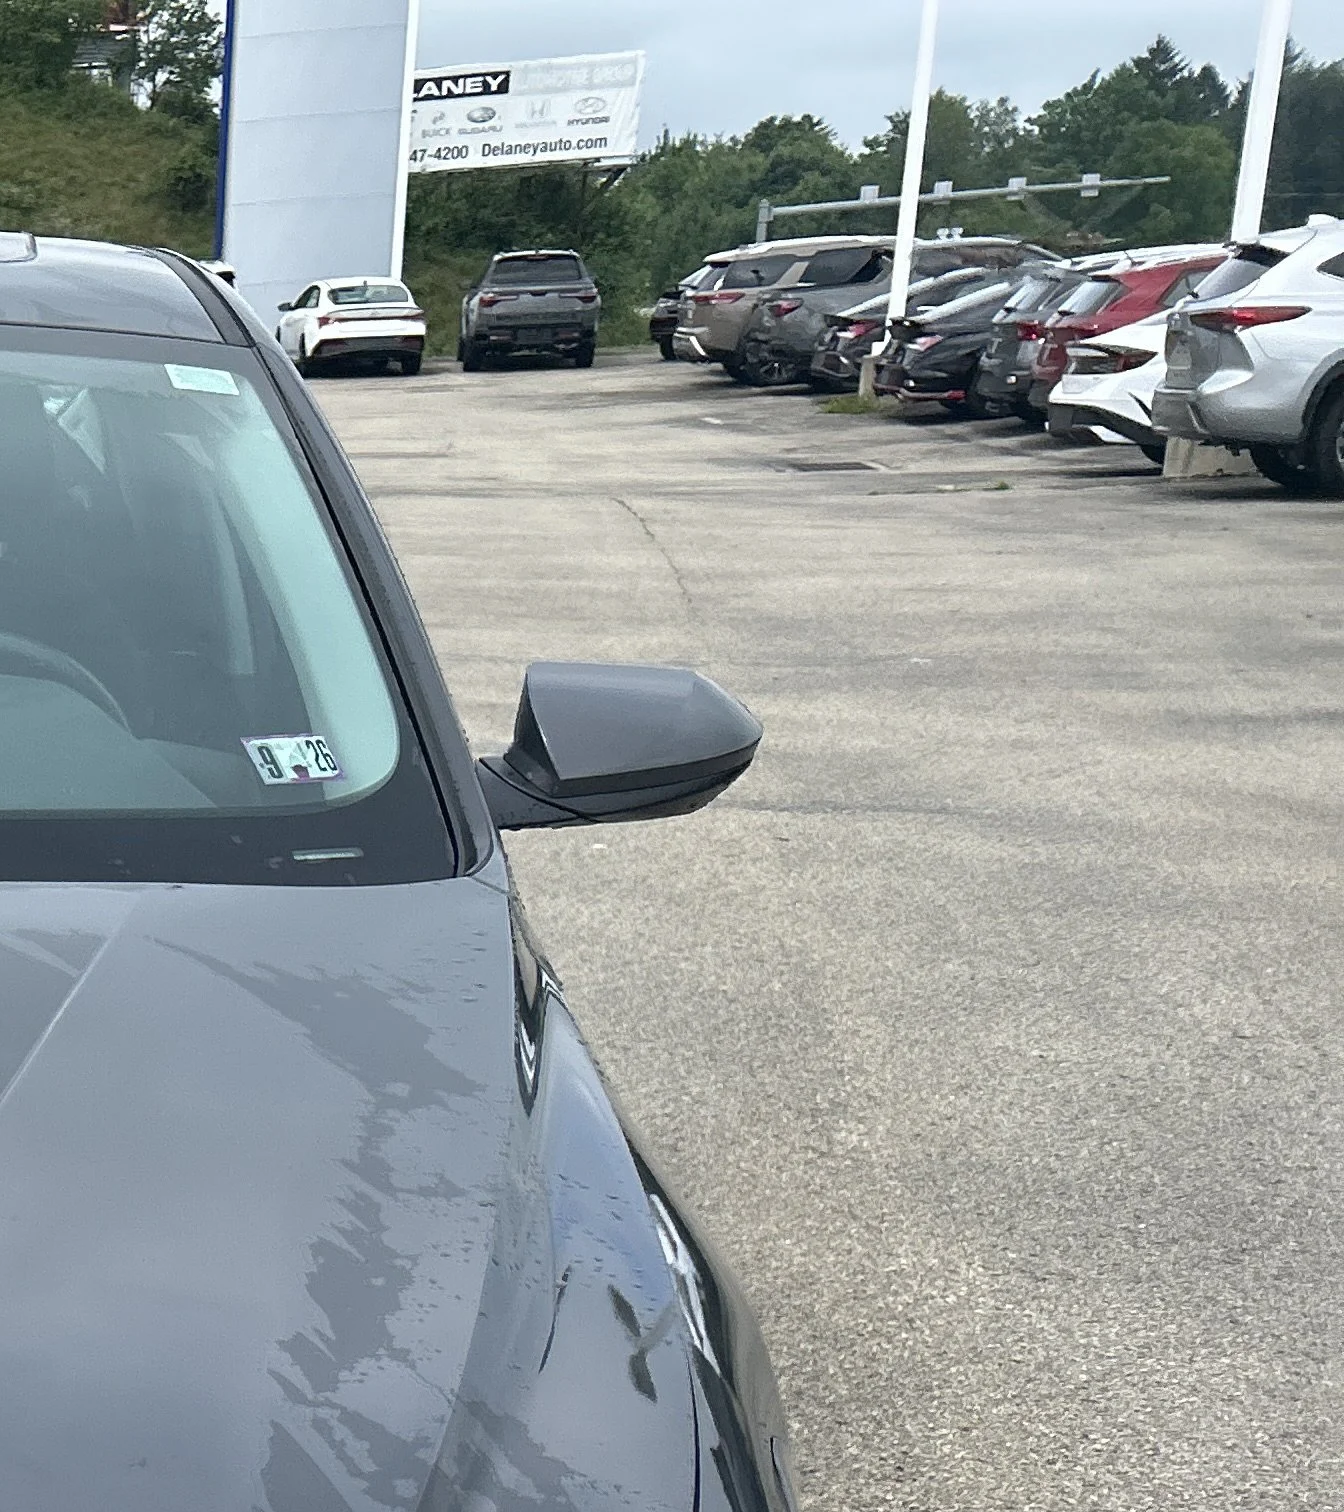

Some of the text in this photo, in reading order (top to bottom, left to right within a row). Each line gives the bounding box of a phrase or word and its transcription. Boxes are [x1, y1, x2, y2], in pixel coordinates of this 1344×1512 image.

[567, 116, 610, 126] HYUNDAI
[458, 125, 503, 135] SUBARU
[481, 136, 608, 158] Delaneyauto.com
[257, 739, 338, 779] 9 26
